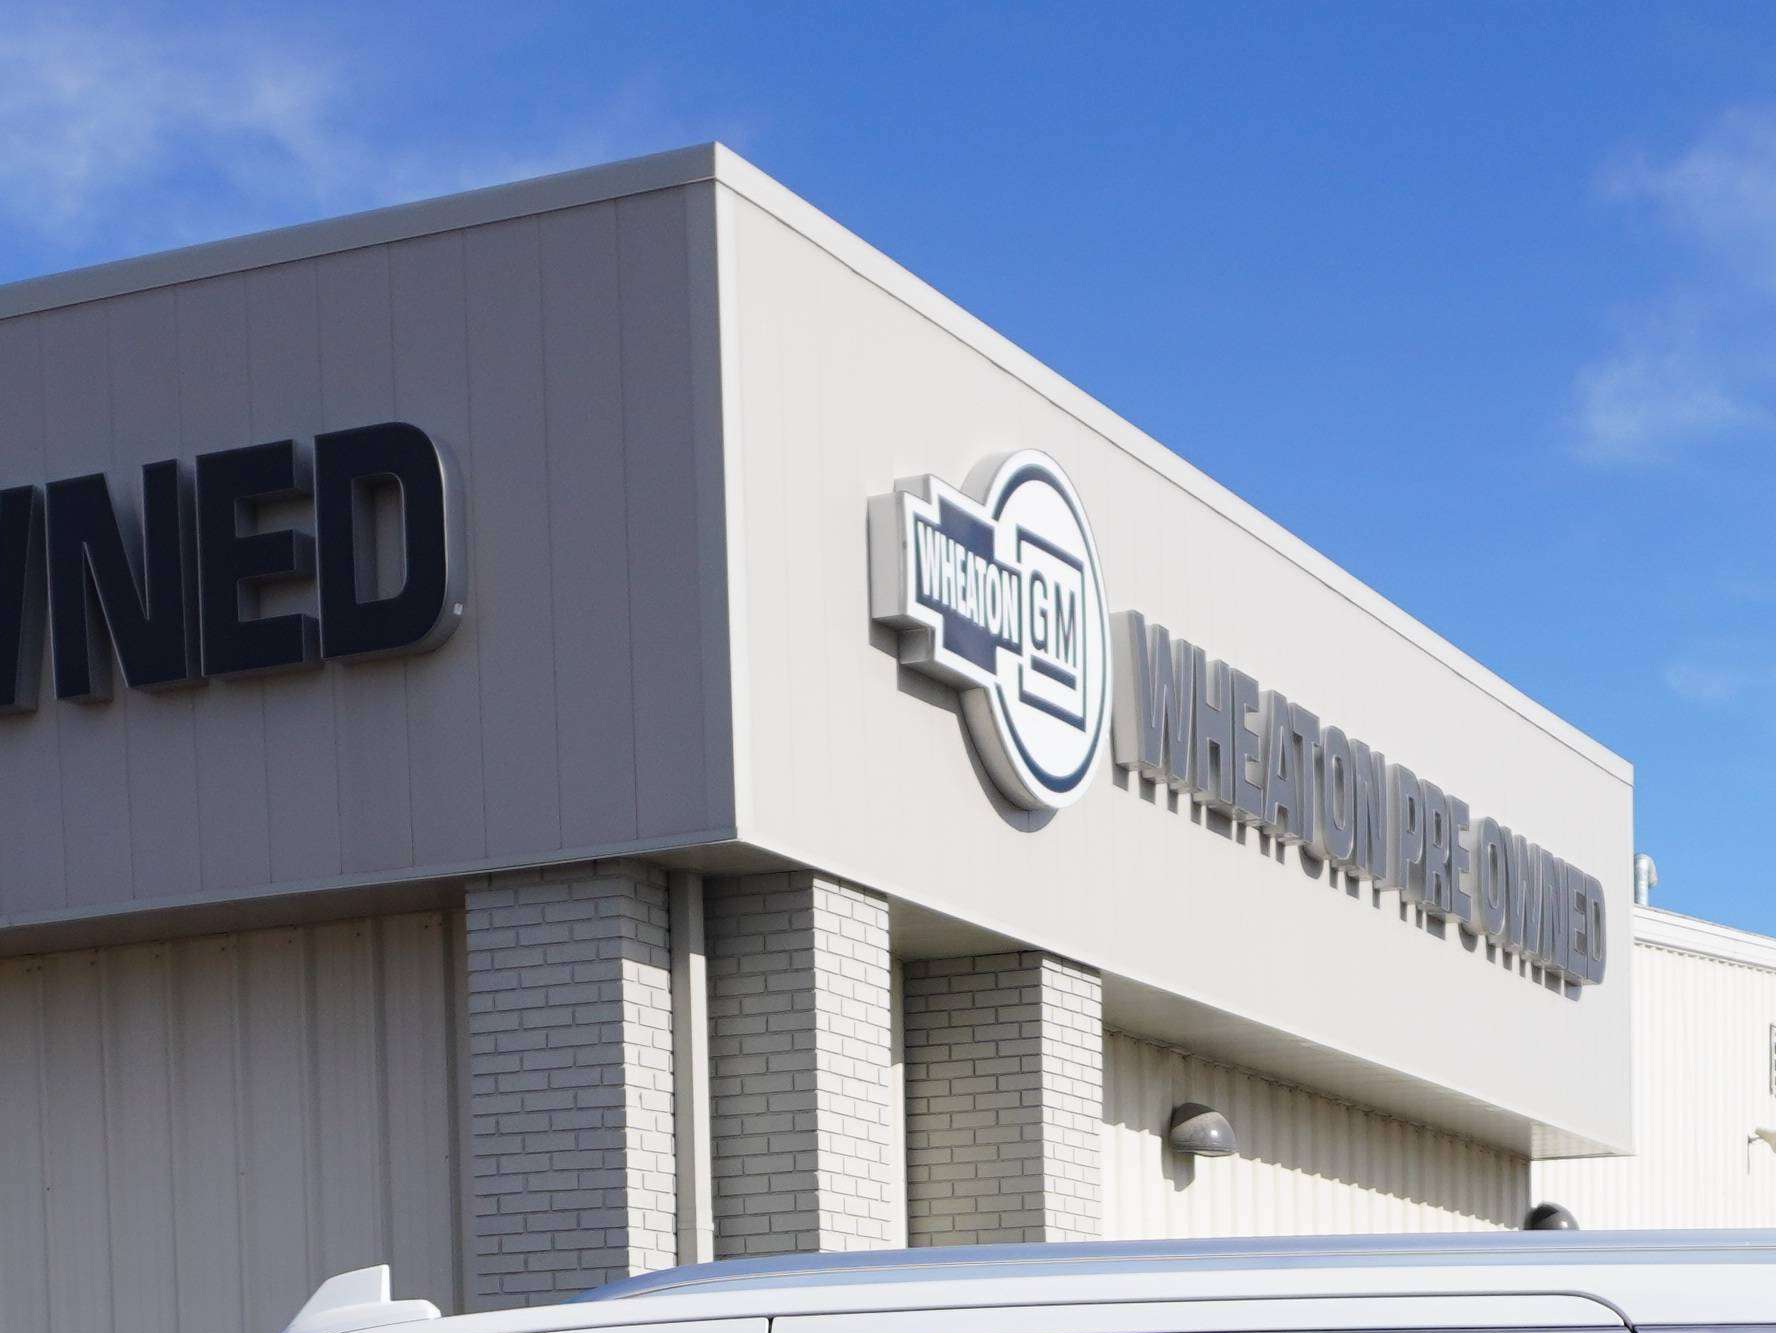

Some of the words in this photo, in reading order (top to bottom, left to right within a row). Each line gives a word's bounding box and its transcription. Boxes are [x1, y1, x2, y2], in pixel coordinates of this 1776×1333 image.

[915, 519, 1020, 645] WHEATON
[1029, 569, 1077, 668] GM
[1120, 609, 1386, 880] WHEATON
[1391, 763, 1471, 924] PRE
[1475, 816, 1608, 985] OWNED
